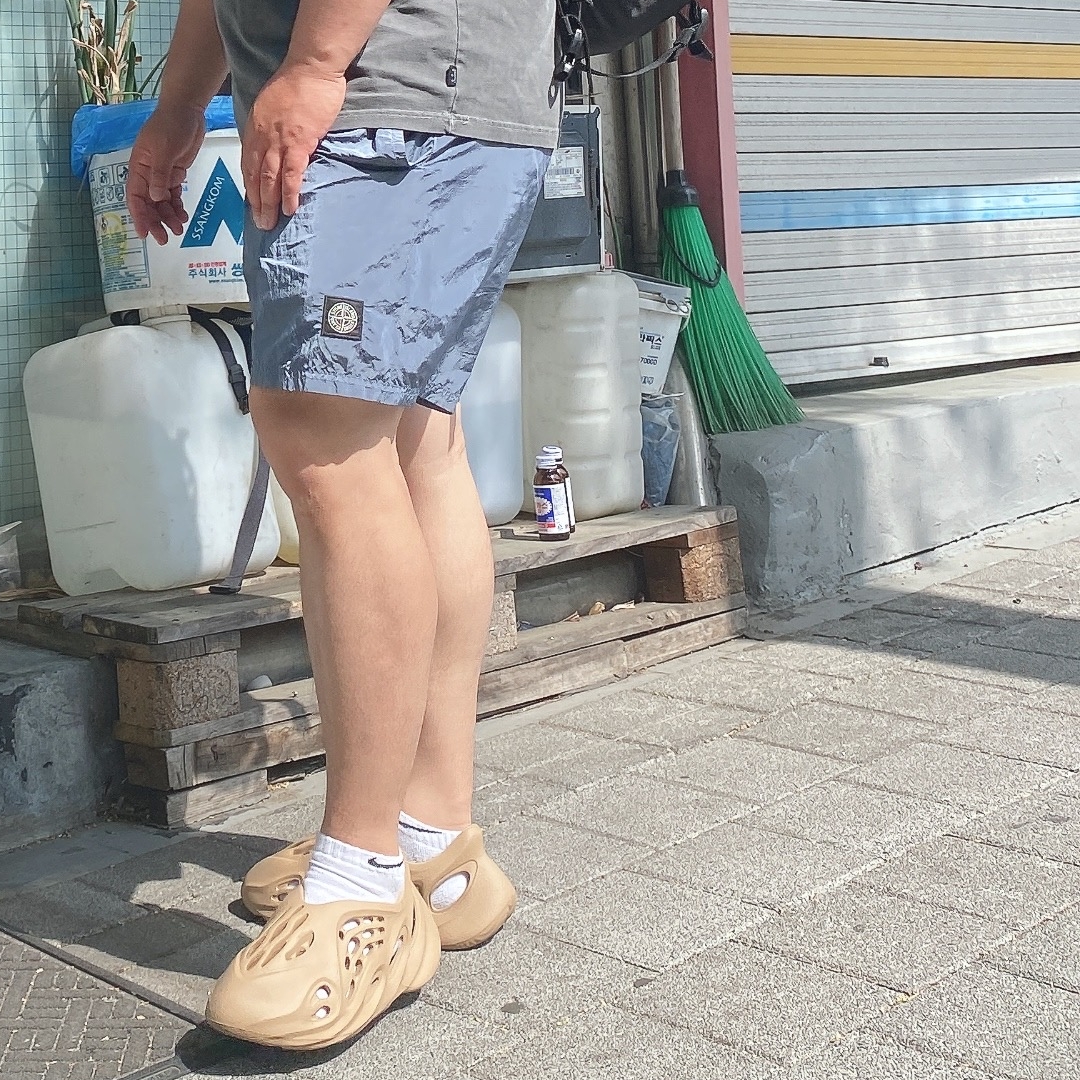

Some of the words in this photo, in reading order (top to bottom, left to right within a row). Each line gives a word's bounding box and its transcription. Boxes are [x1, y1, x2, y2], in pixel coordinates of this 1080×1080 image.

[192, 176, 226, 240] SSANGKOM
[188, 267, 227, 279] 주식회사
[231, 263, 244, 277] 쌍
